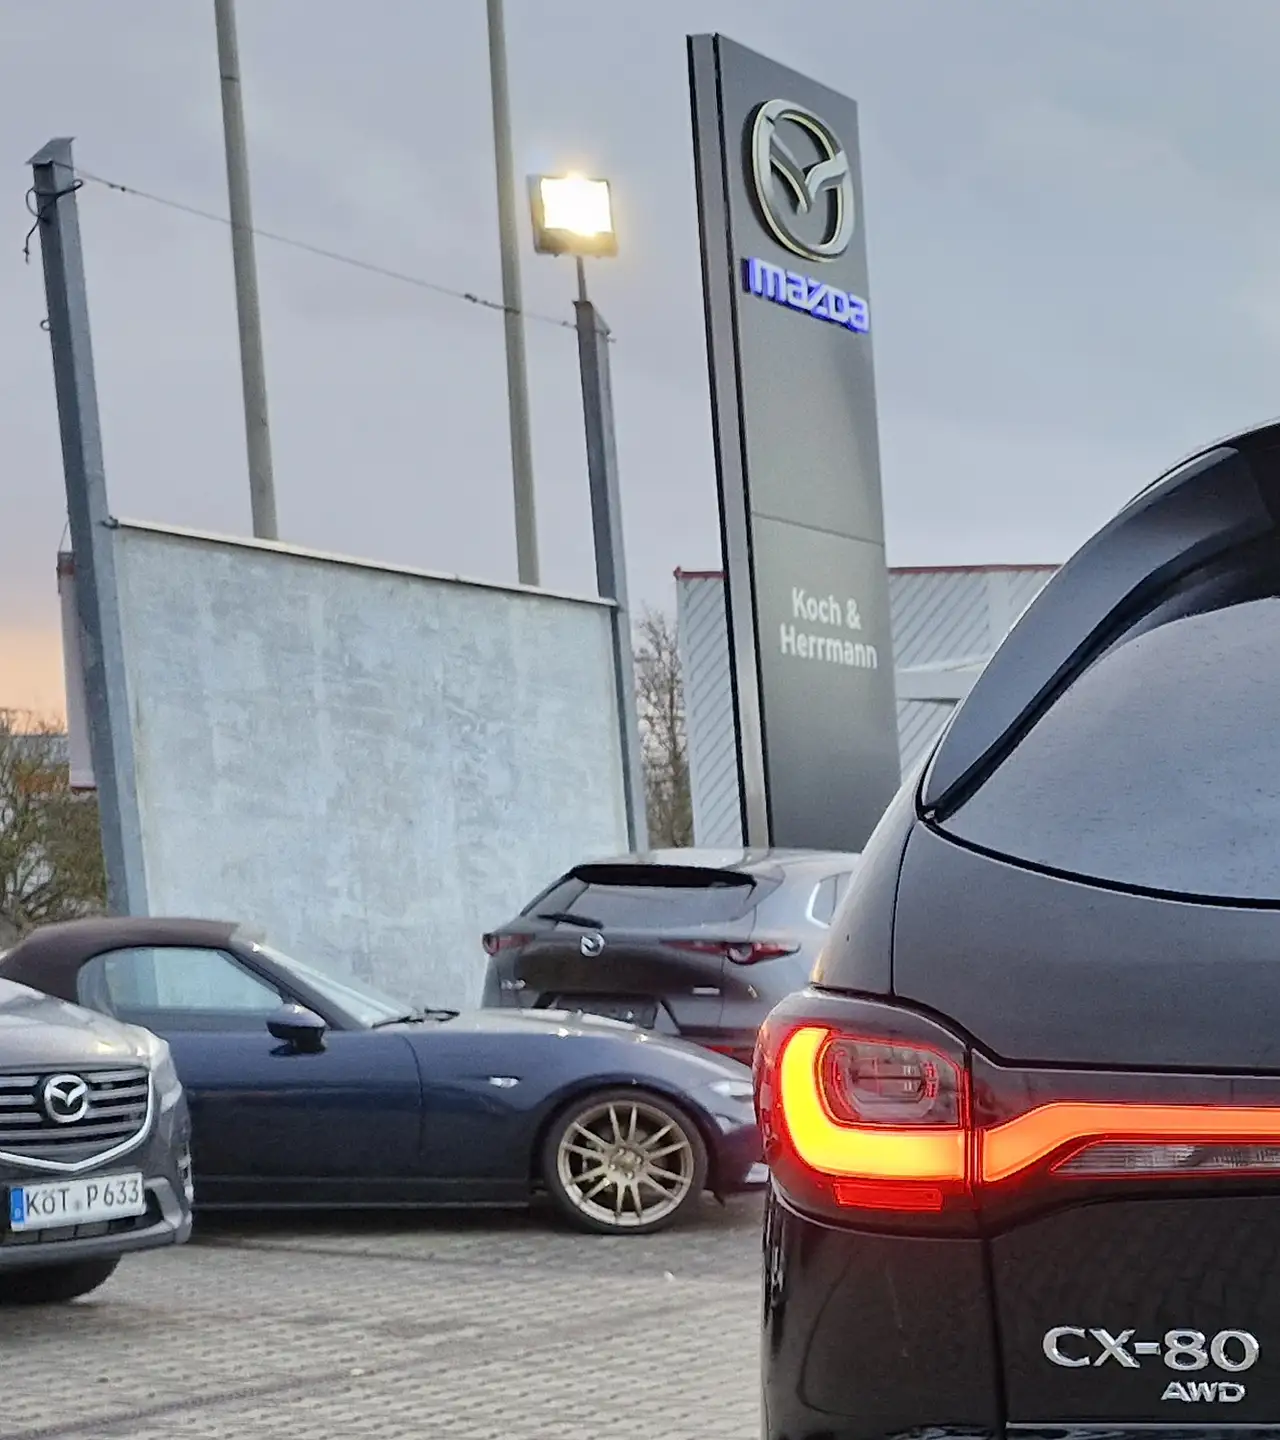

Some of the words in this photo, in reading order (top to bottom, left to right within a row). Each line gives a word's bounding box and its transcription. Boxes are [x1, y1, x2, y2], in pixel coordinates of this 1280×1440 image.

[792, 587, 841, 626] Koch
[846, 598, 862, 630] &
[780, 622, 878, 669] Herrmann
[26, 1187, 70, 1216] KÖT
[1042, 1325, 1260, 1372] CX-80
[1160, 1381, 1246, 1403] AWD
